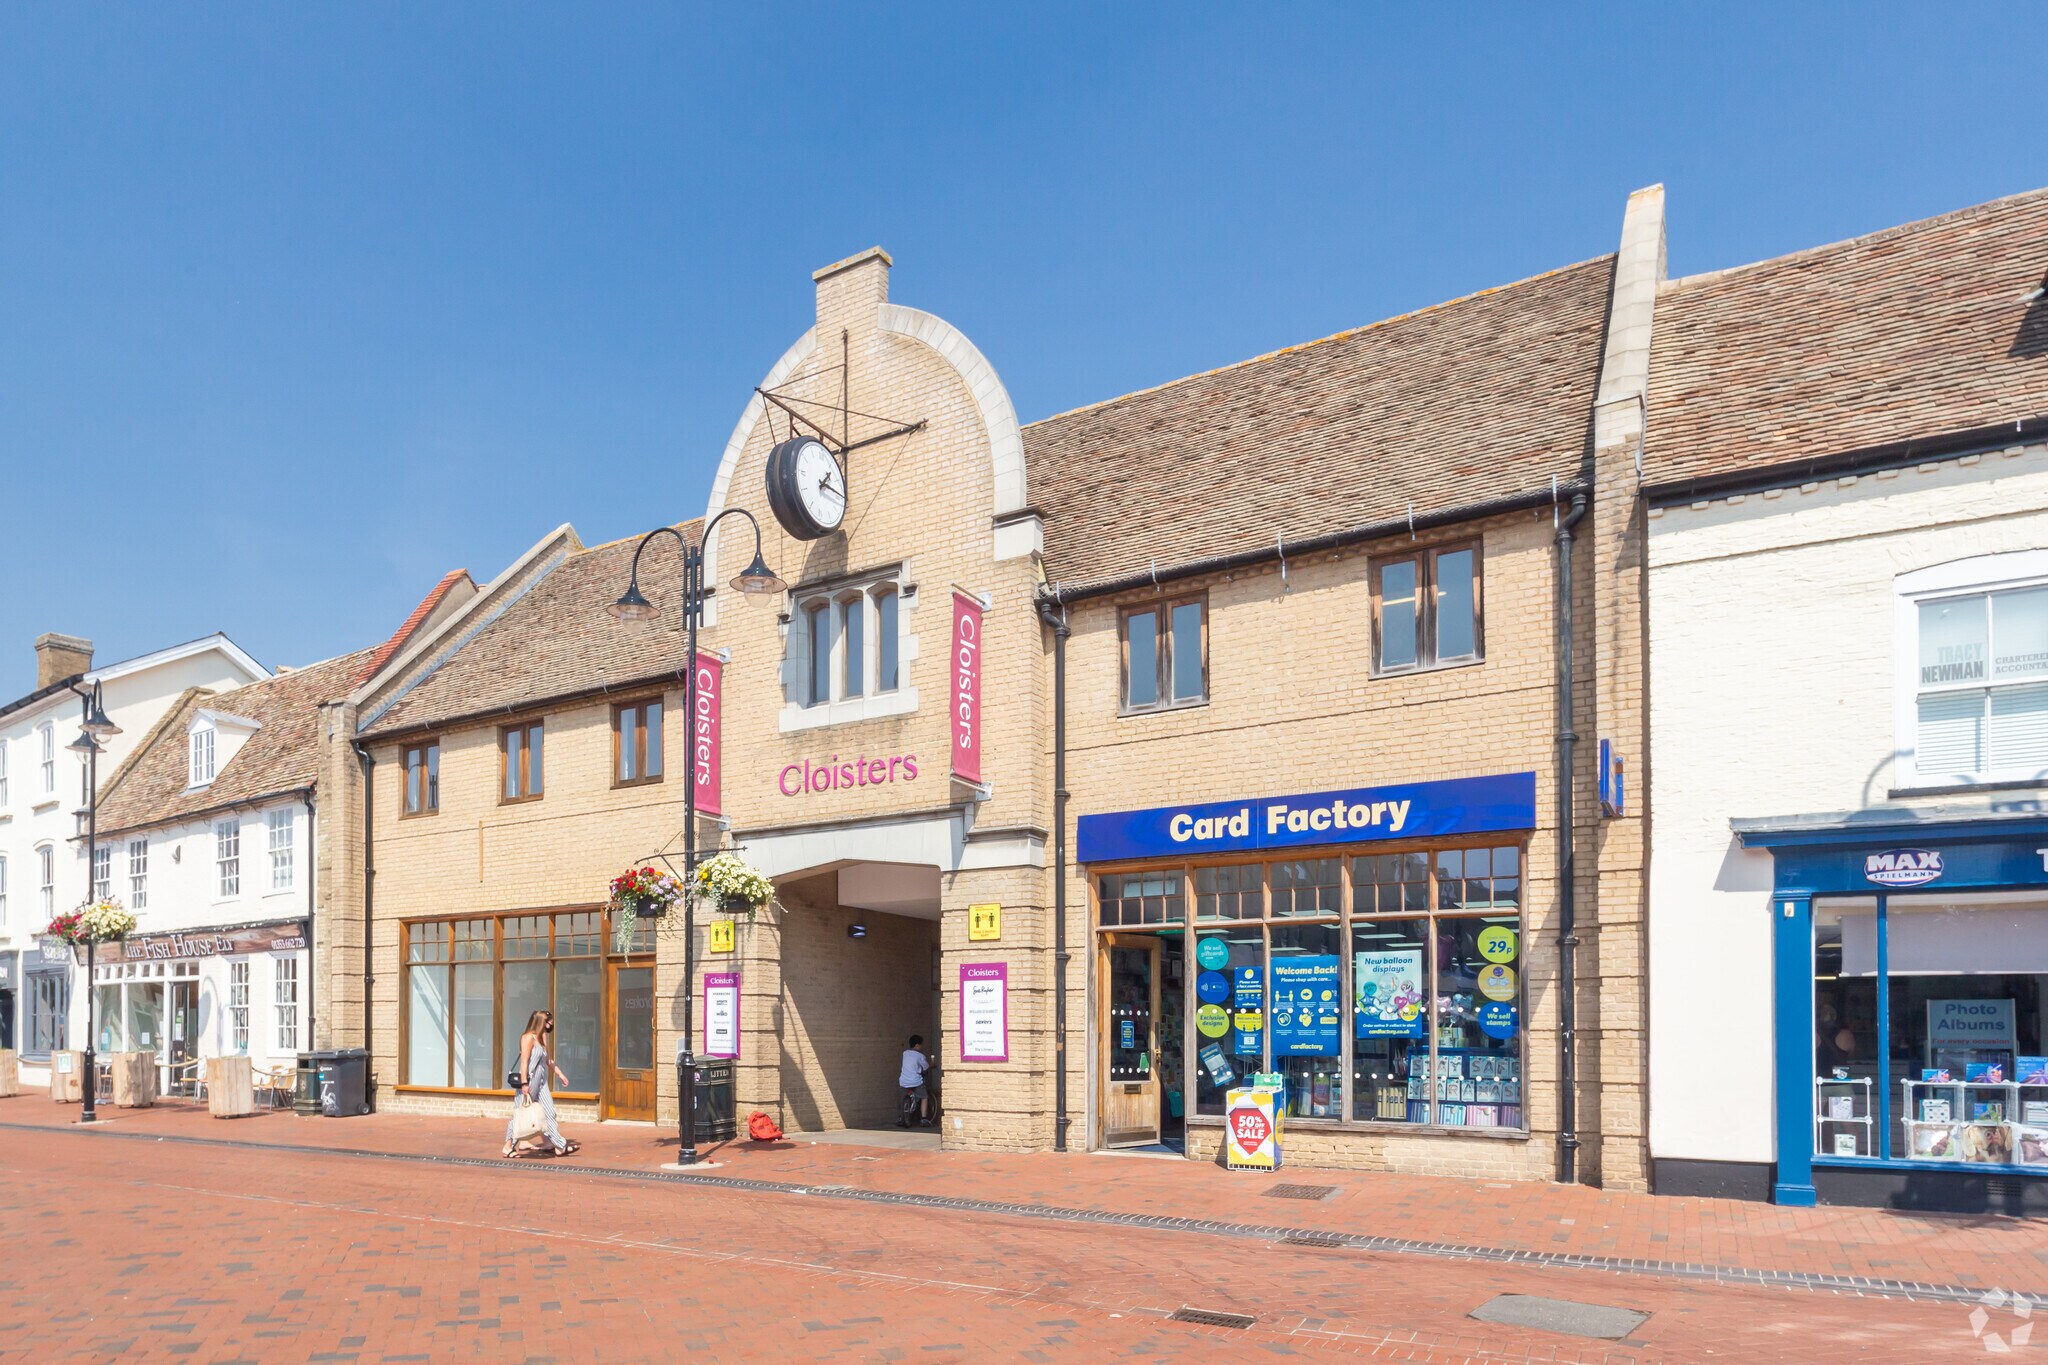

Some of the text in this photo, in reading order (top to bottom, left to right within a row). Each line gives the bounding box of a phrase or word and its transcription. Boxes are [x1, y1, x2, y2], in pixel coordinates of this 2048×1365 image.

[1937, 643, 1983, 664] TRACY
[1921, 661, 1984, 683] NEWMAN
[958, 614, 976, 749] Cloisters
[697, 668, 717, 786] Cloisters
[779, 754, 919, 796] Cloisters
[1169, 800, 1411, 842] Card Factory
[1867, 852, 1941, 872] MAX
[125, 934, 234, 959] THE FISH HOUSE ELY
[1488, 940, 1512, 955] 29p
[968, 968, 999, 977] Cloisters
[1275, 965, 1338, 975] Welcome Back!
[1372, 965, 1405, 974] displays
[710, 977, 734, 985] Cloisters
[1945, 1004, 1997, 1015] Photo
[1937, 1019, 2005, 1030] Albums
[1290, 1043, 1323, 1051] cardfactory
[1238, 1115, 1263, 1128] 50%
[1237, 1128, 1265, 1139] SALE
